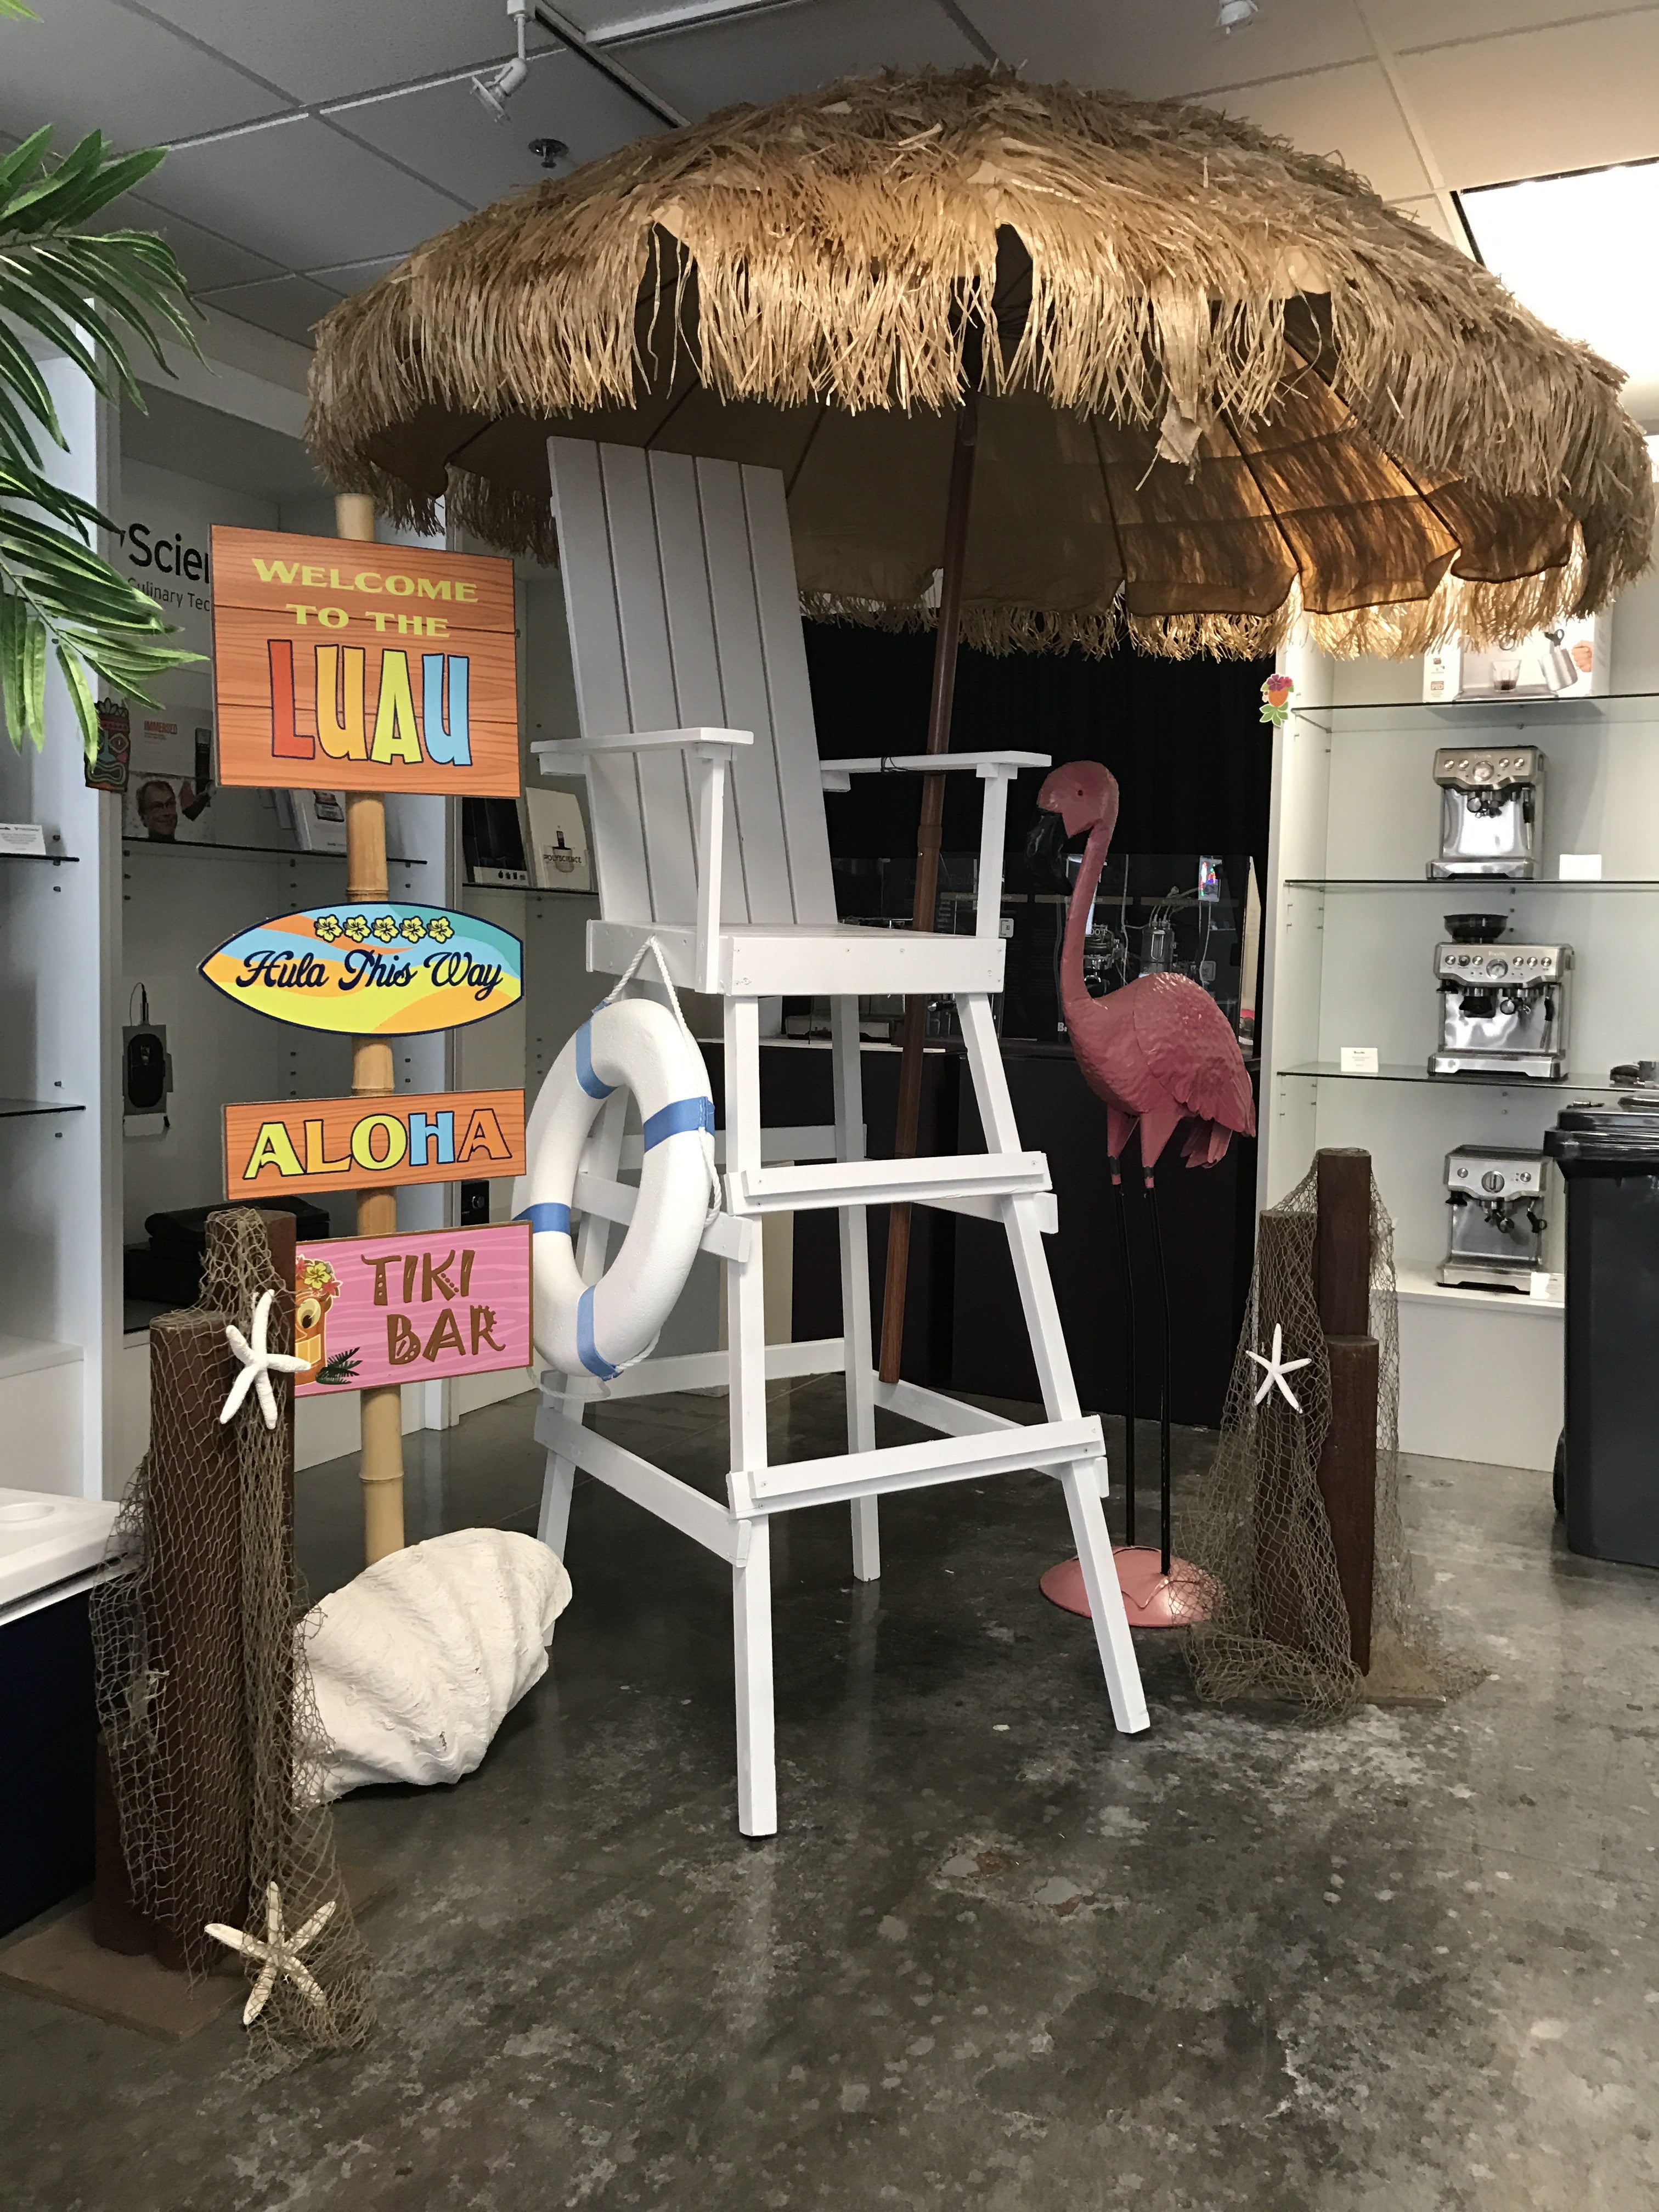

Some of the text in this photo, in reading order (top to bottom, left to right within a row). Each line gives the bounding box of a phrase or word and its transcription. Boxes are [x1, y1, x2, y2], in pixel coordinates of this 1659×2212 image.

[252, 558, 479, 602] WELCOME
[285, 603, 450, 637] TO THE
[267, 639, 473, 766] LUAU
[236, 949, 504, 1001] Hula This Way
[242, 1108, 513, 1180] ALOHA
[360, 1249, 476, 1306] TIKI
[386, 1305, 506, 1365] BAR
